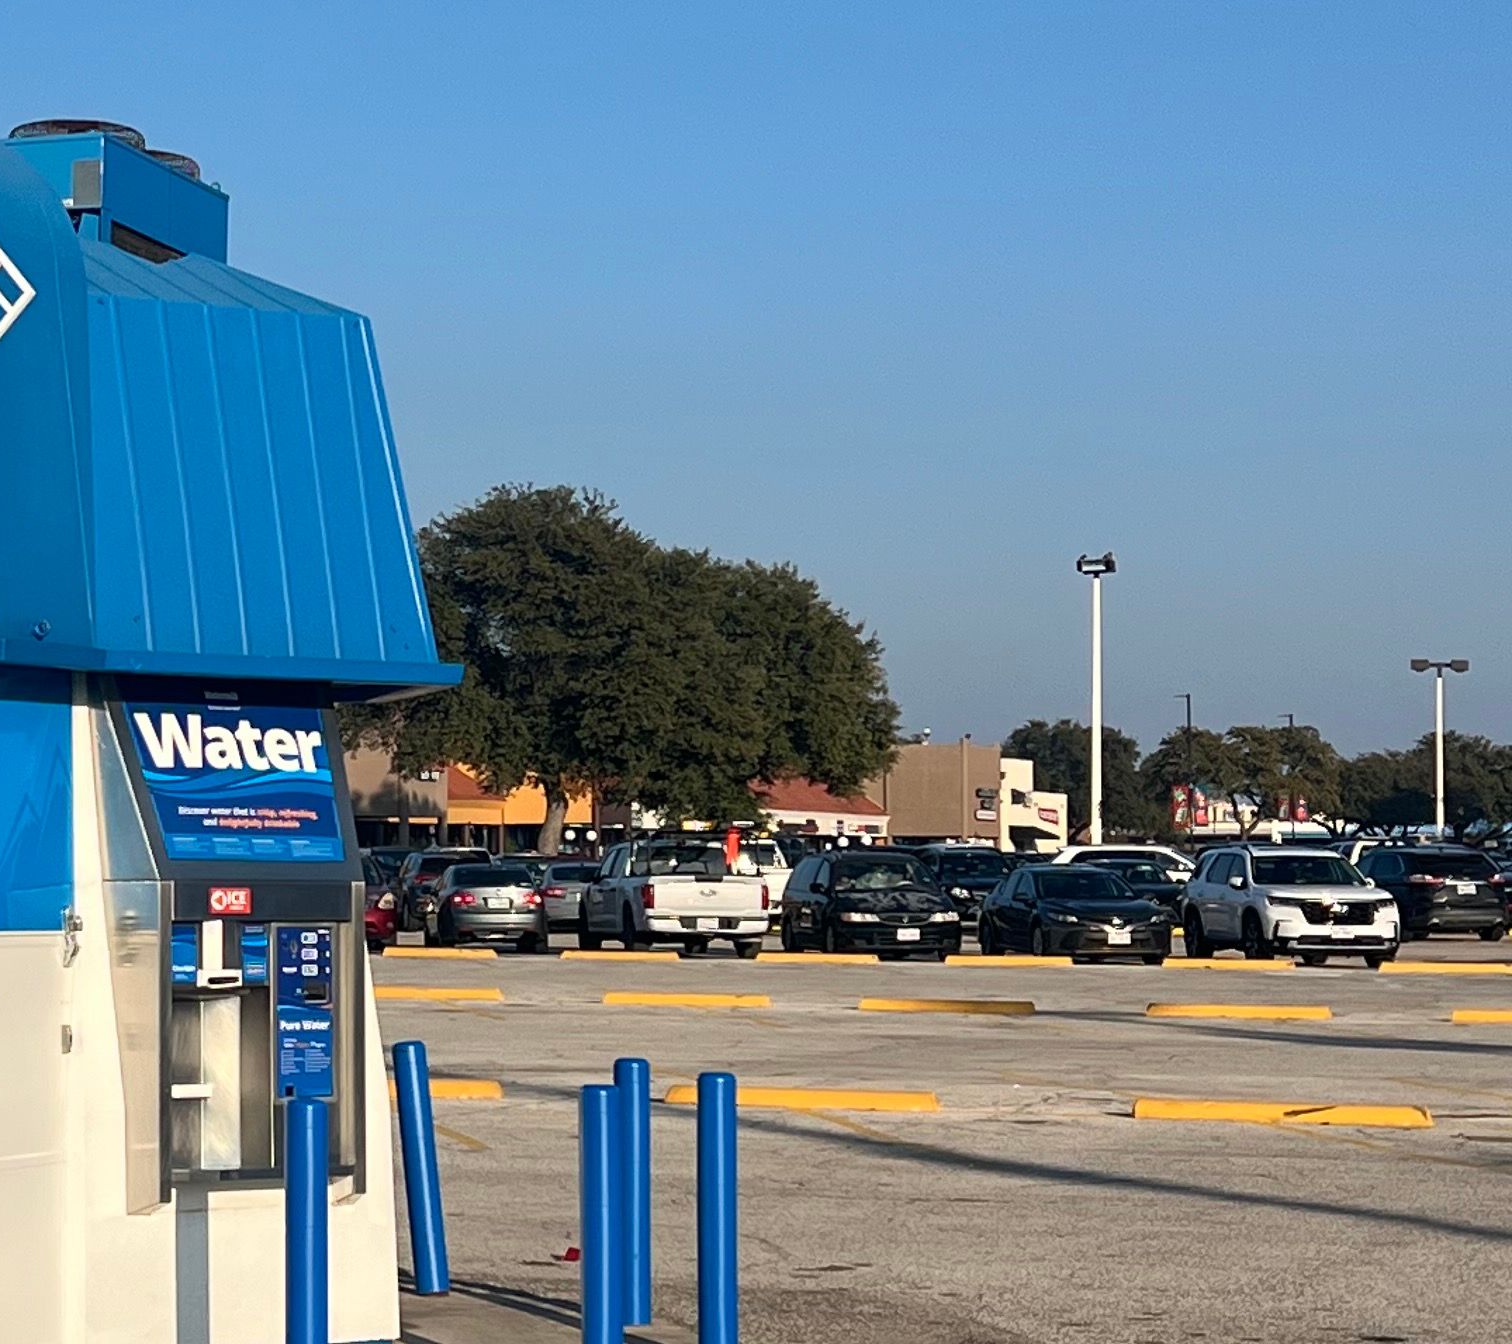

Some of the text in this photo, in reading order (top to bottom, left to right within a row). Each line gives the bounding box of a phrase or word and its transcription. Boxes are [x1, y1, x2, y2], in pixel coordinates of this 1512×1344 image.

[133, 712, 322, 774] Water
[226, 890, 247, 905] ICE
[280, 1020, 331, 1031] Pure Water
